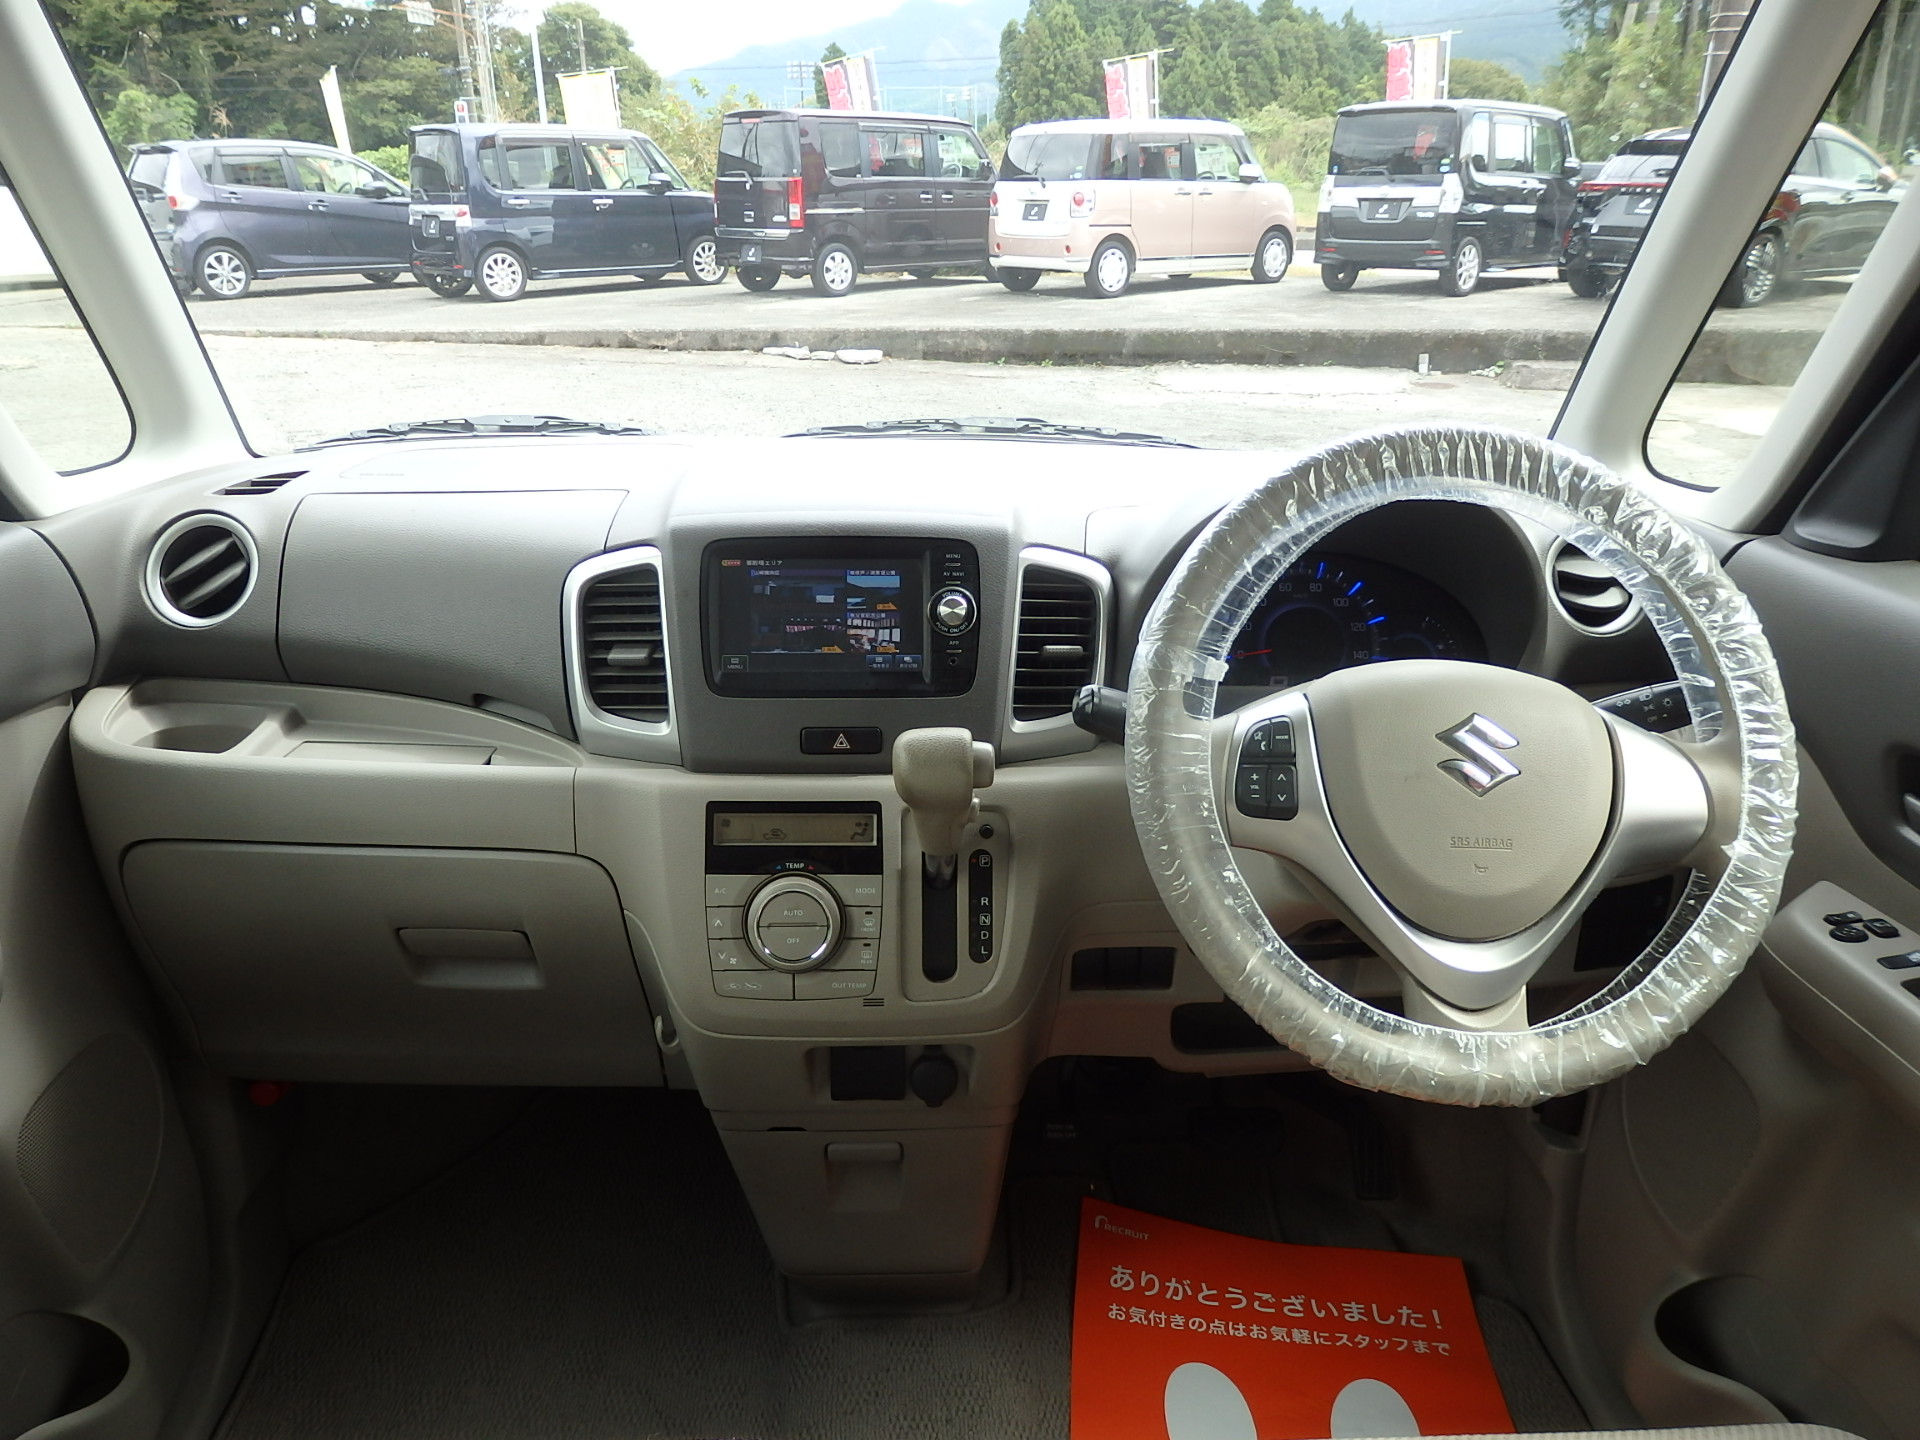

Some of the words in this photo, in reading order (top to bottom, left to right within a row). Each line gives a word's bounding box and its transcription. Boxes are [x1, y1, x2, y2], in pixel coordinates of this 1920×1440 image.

[1278, 582, 1292, 591] 60
[1309, 582, 1322, 592] 80
[1332, 597, 1349, 607] 100
[935, 621, 948, 632] PUSH
[949, 622, 969, 633] ON/OFF
[1350, 621, 1366, 632] 120
[1353, 650, 1369, 660] 140
[1449, 836, 1470, 847] SRS
[1473, 837, 1513, 849] AIRBAG
[981, 856, 989, 865] P
[980, 896, 989, 906] R
[783, 909, 803, 917] AUTO
[981, 914, 989, 924] N
[980, 930, 989, 940] D
[981, 945, 988, 954] L
[1103, 1222, 1150, 1242] RECRUIT
[1109, 1264, 1443, 1330] ありがとうございました！
[1107, 1303, 1451, 1356] お気付きの点はお気軽にスタッフまで
